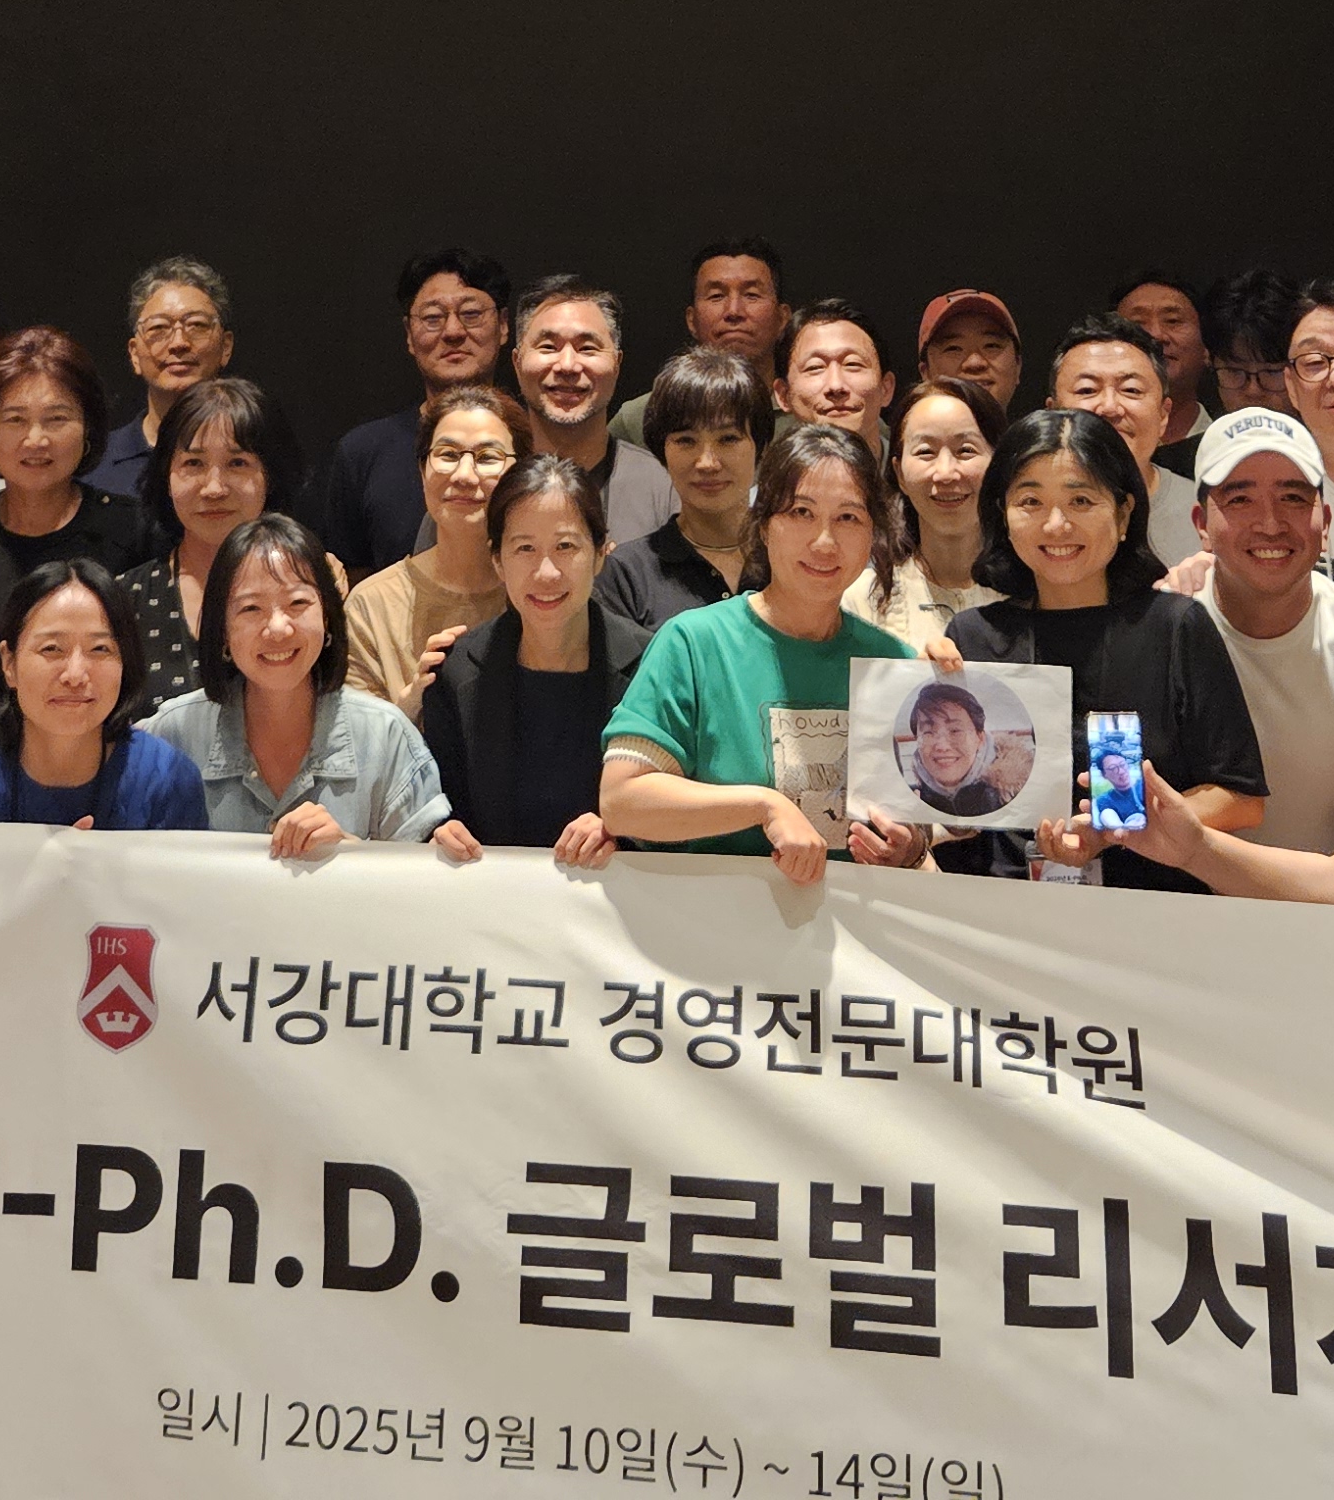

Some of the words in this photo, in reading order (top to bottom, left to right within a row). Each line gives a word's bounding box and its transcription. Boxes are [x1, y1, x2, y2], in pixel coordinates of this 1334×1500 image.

[1224, 415, 1294, 440] VERUTUM
[778, 711, 849, 731] howd
[97, 936, 127, 955] IHS
[197, 956, 569, 1055] 서강대학교
[599, 981, 1147, 1111] 경영전문대학원
[507, 1161, 942, 1358] 글로벌
[157, 1387, 242, 1446] 일시
[285, 1401, 445, 1463] 2025년
[464, 1415, 535, 1470] 9월
[556, 1425, 744, 1498] 10일(수)
